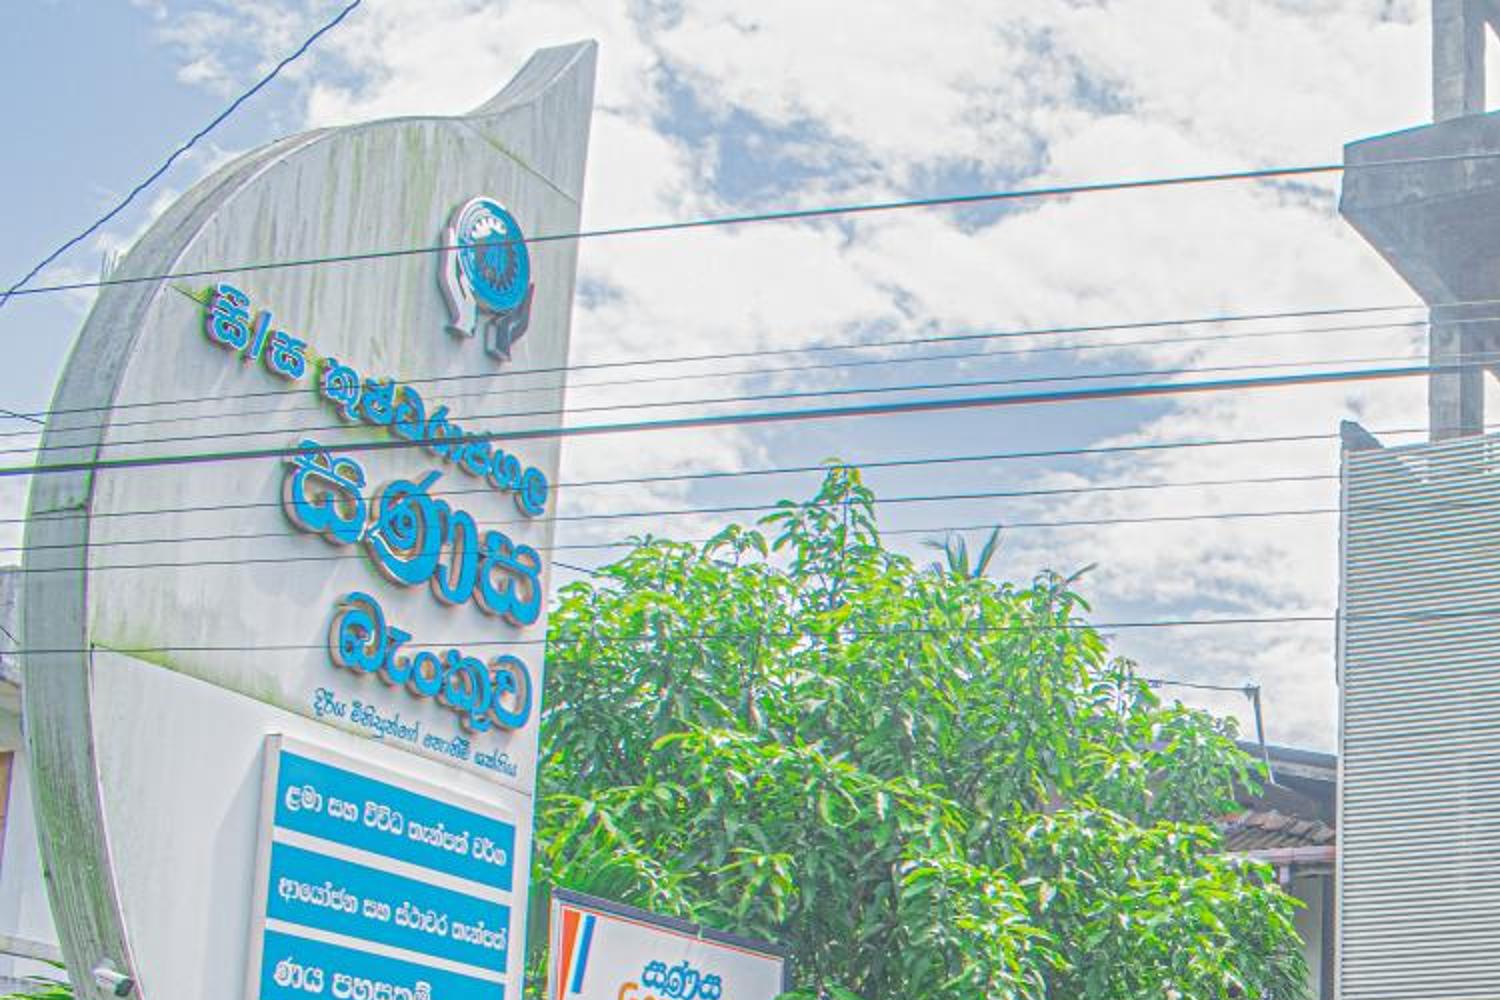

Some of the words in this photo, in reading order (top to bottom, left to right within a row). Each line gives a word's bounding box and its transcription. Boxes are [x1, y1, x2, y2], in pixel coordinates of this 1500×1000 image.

[330, 590, 533, 732] බැංකුව
[285, 784, 323, 812] ළමා
[328, 795, 358, 821] සහ
[364, 800, 402, 832] විවිධ
[278, 876, 357, 914] ආයෝජන
[363, 900, 390, 921] සහ
[273, 956, 324, 994] ණය
